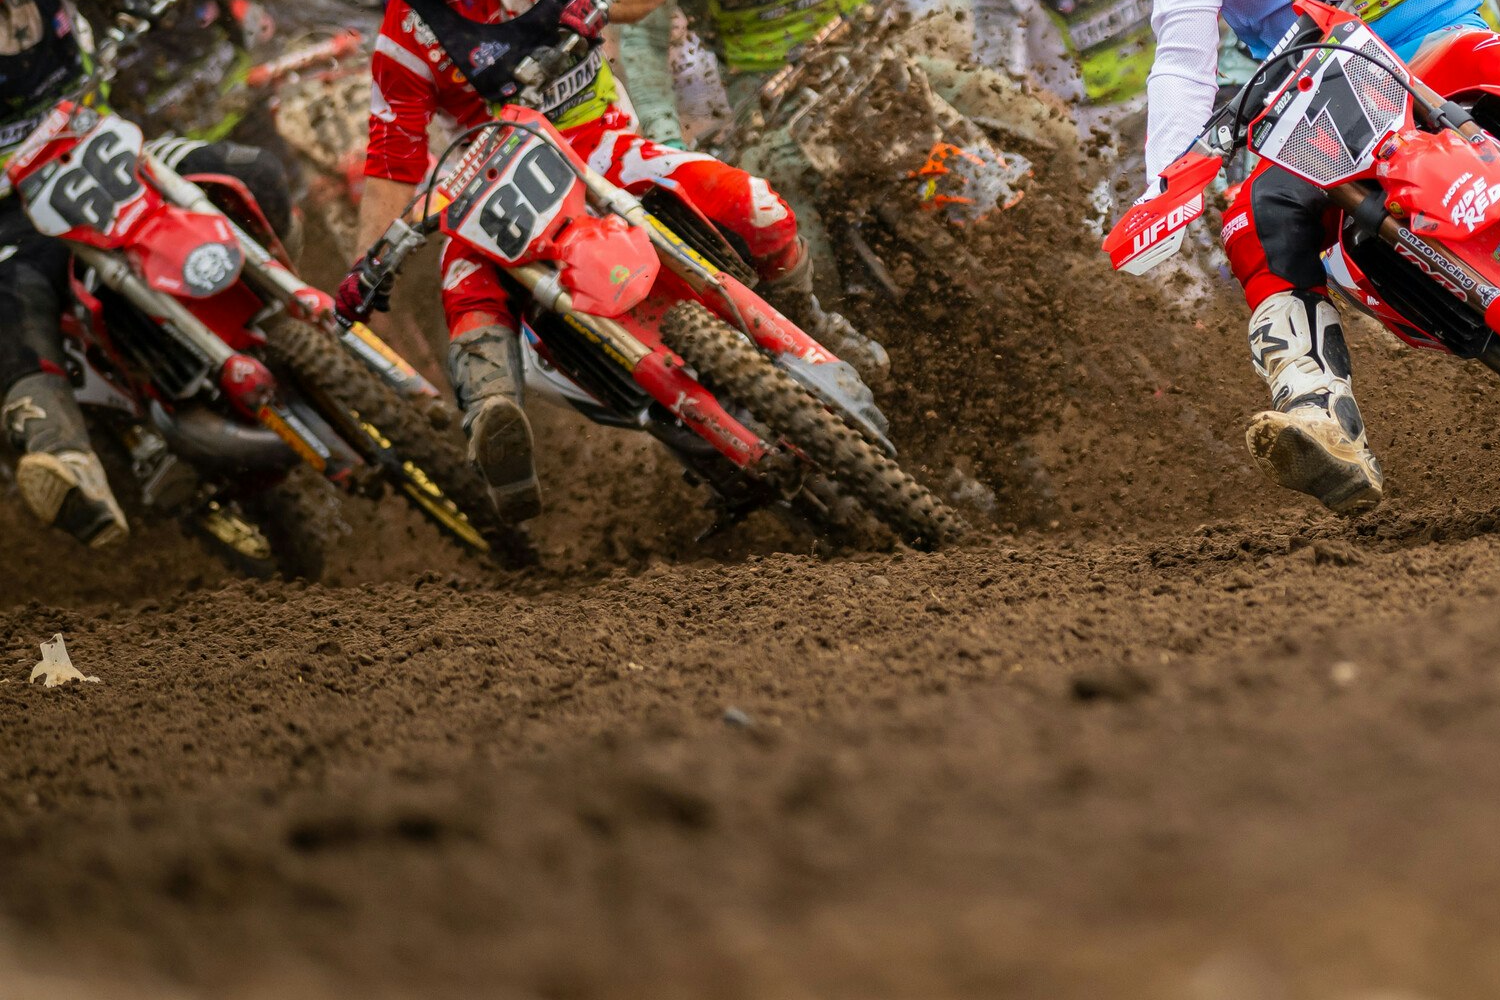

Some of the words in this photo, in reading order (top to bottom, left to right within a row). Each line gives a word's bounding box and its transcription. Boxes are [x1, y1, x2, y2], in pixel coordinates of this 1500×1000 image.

[1273, 91, 1293, 114] 2022
[50, 131, 141, 233] 66
[479, 140, 577, 260] 80
[1442, 172, 1473, 207] MOTUL
[1451, 177, 1488, 227] RIDE
[1133, 205, 1184, 254] UFO
